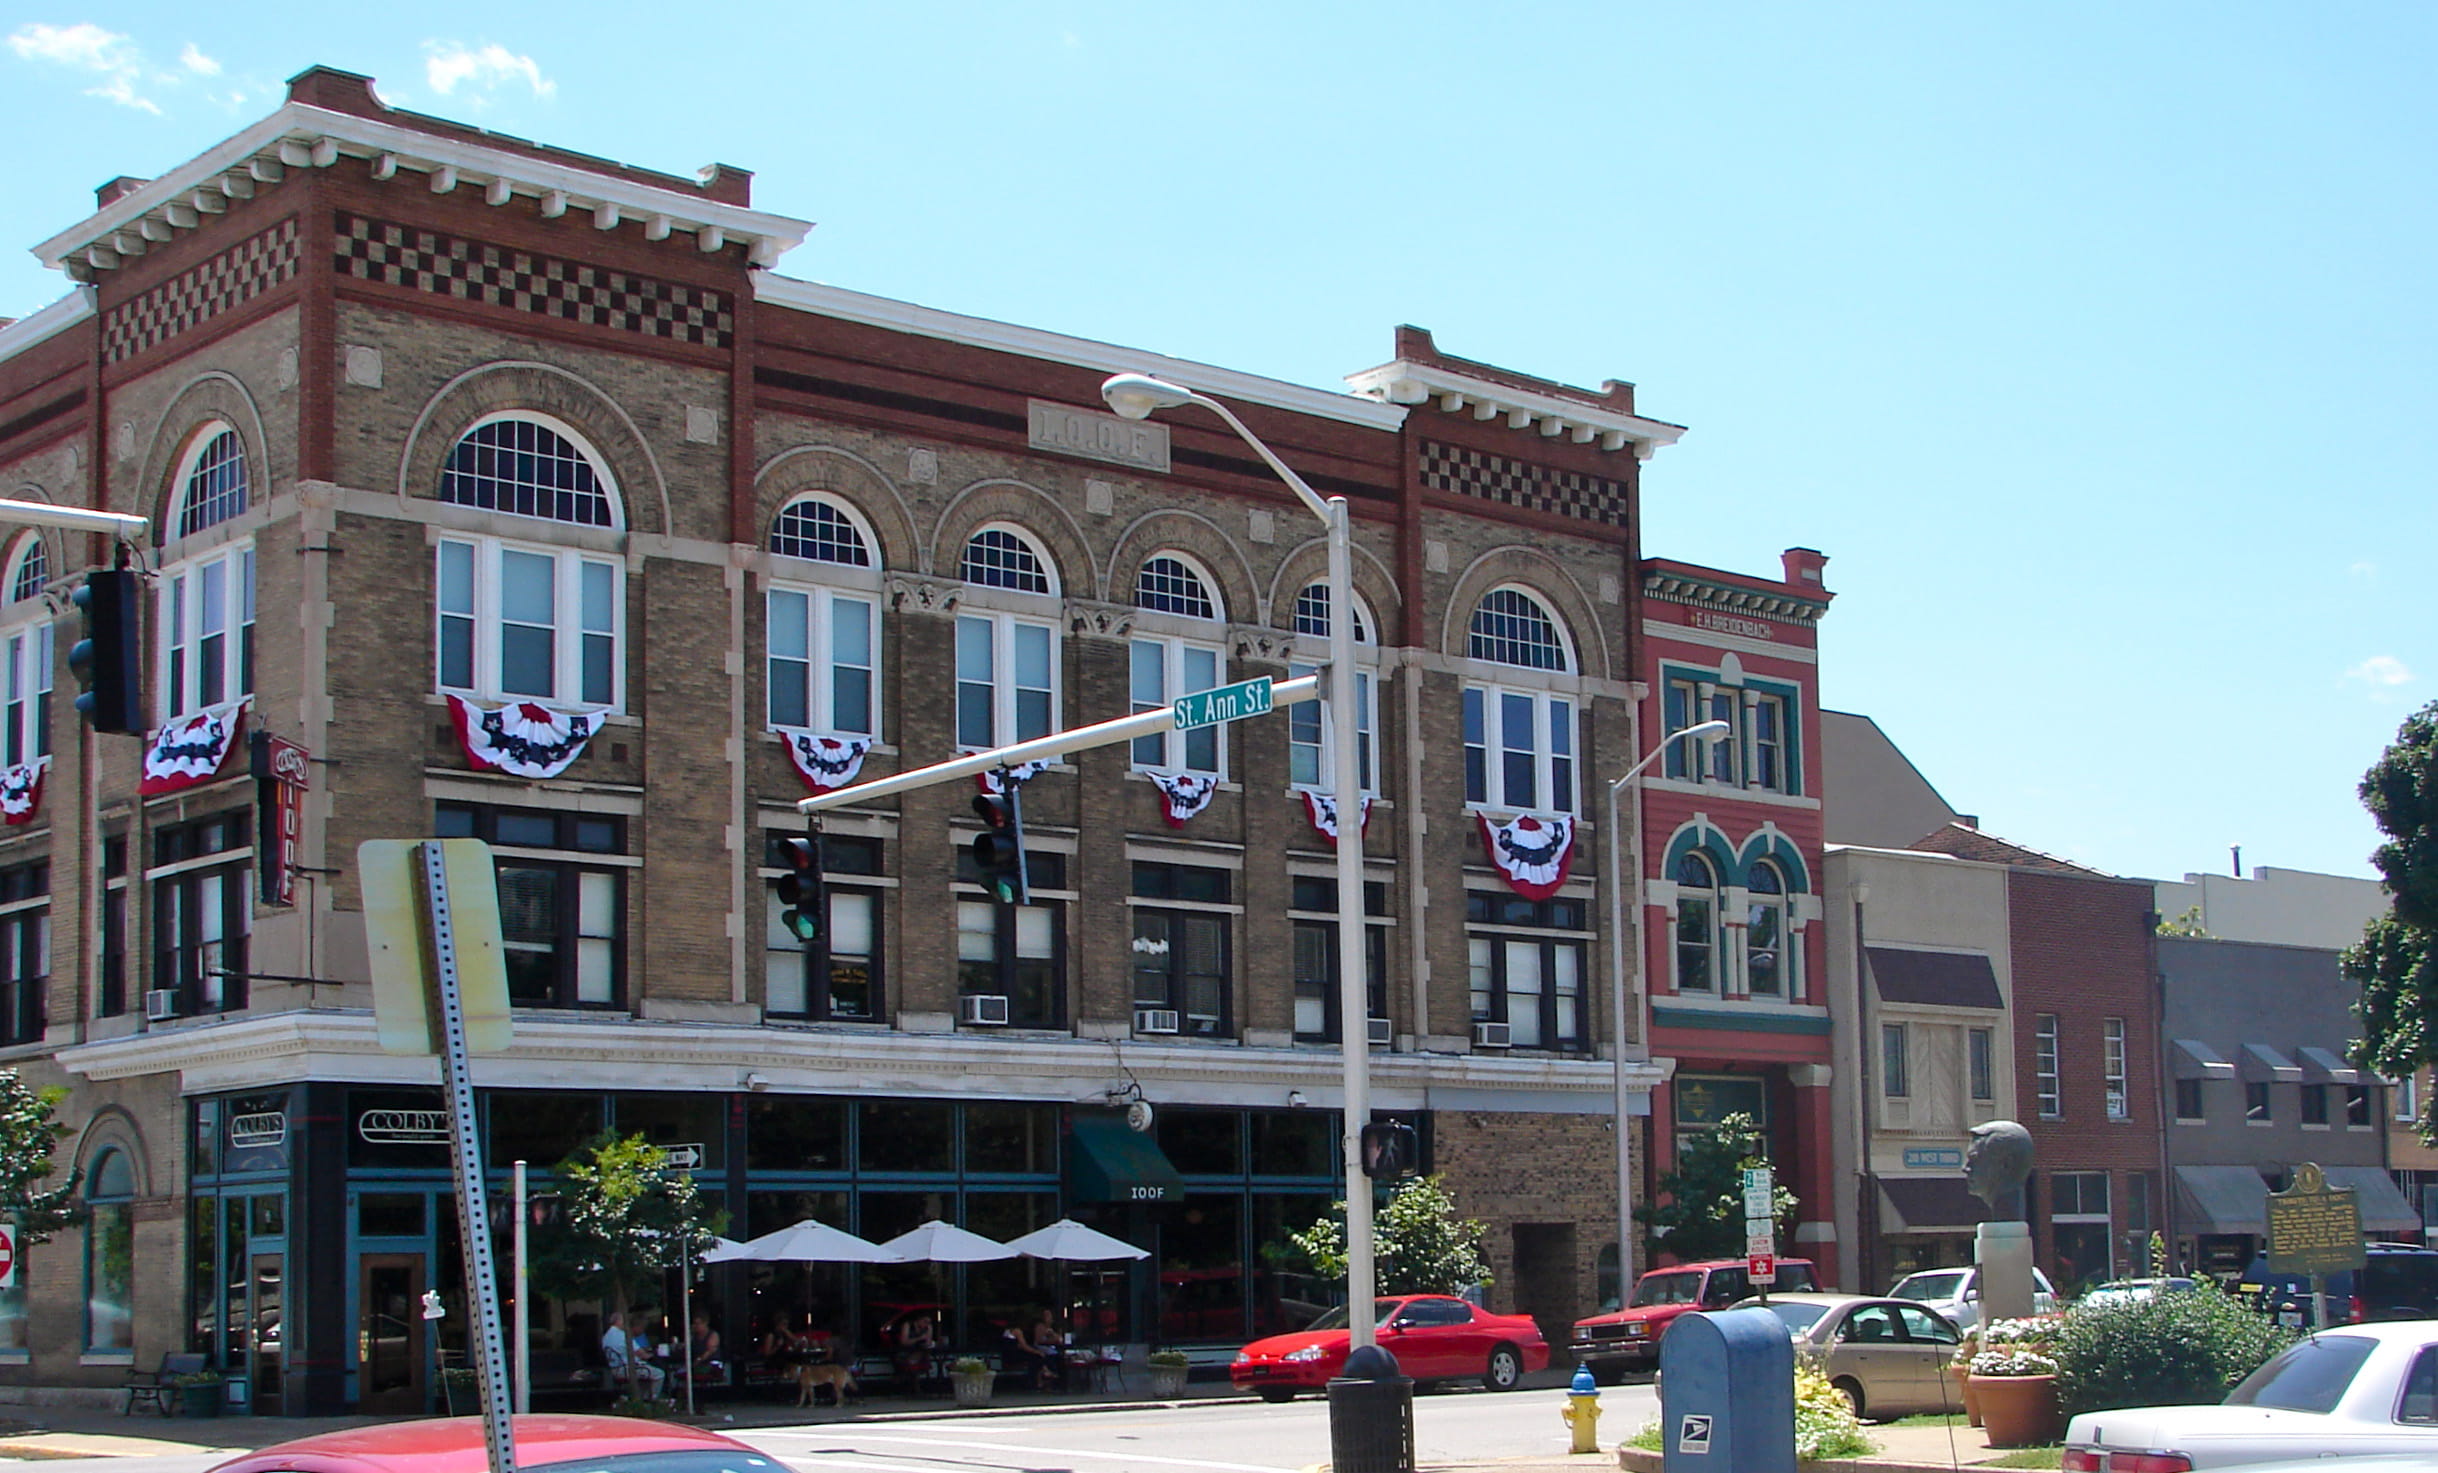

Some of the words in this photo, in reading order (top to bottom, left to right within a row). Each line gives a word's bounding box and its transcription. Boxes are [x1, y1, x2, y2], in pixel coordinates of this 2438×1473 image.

[1175, 700, 1199, 728] St.
[1204, 693, 1237, 723] Ann
[1244, 683, 1270, 713] St.
[1131, 1187, 1165, 1199] IOOF
